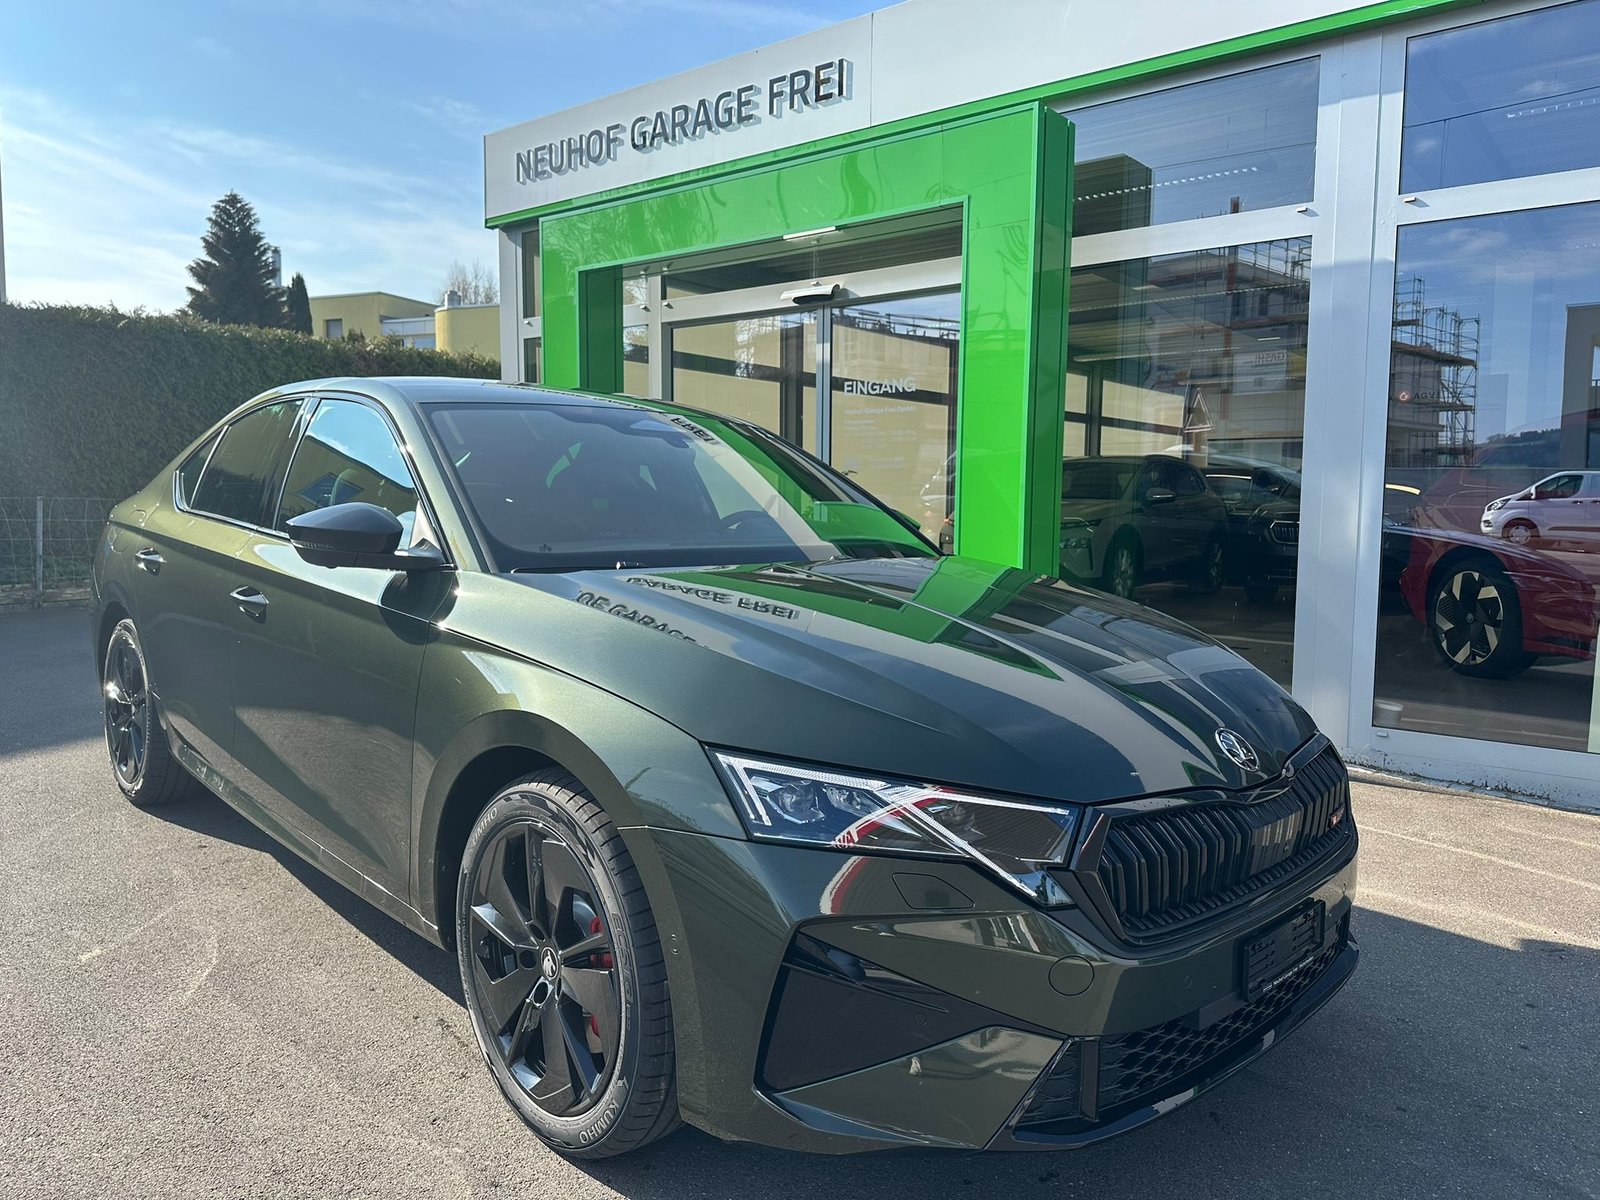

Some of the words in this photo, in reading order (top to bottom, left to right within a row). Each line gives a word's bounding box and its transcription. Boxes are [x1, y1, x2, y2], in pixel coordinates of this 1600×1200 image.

[516, 123, 624, 183] NEUHOF
[631, 84, 758, 150] GARAGE
[769, 57, 849, 116] FREI
[843, 376, 917, 395] EINGANG
[579, 1098, 620, 1144] KUMHO
